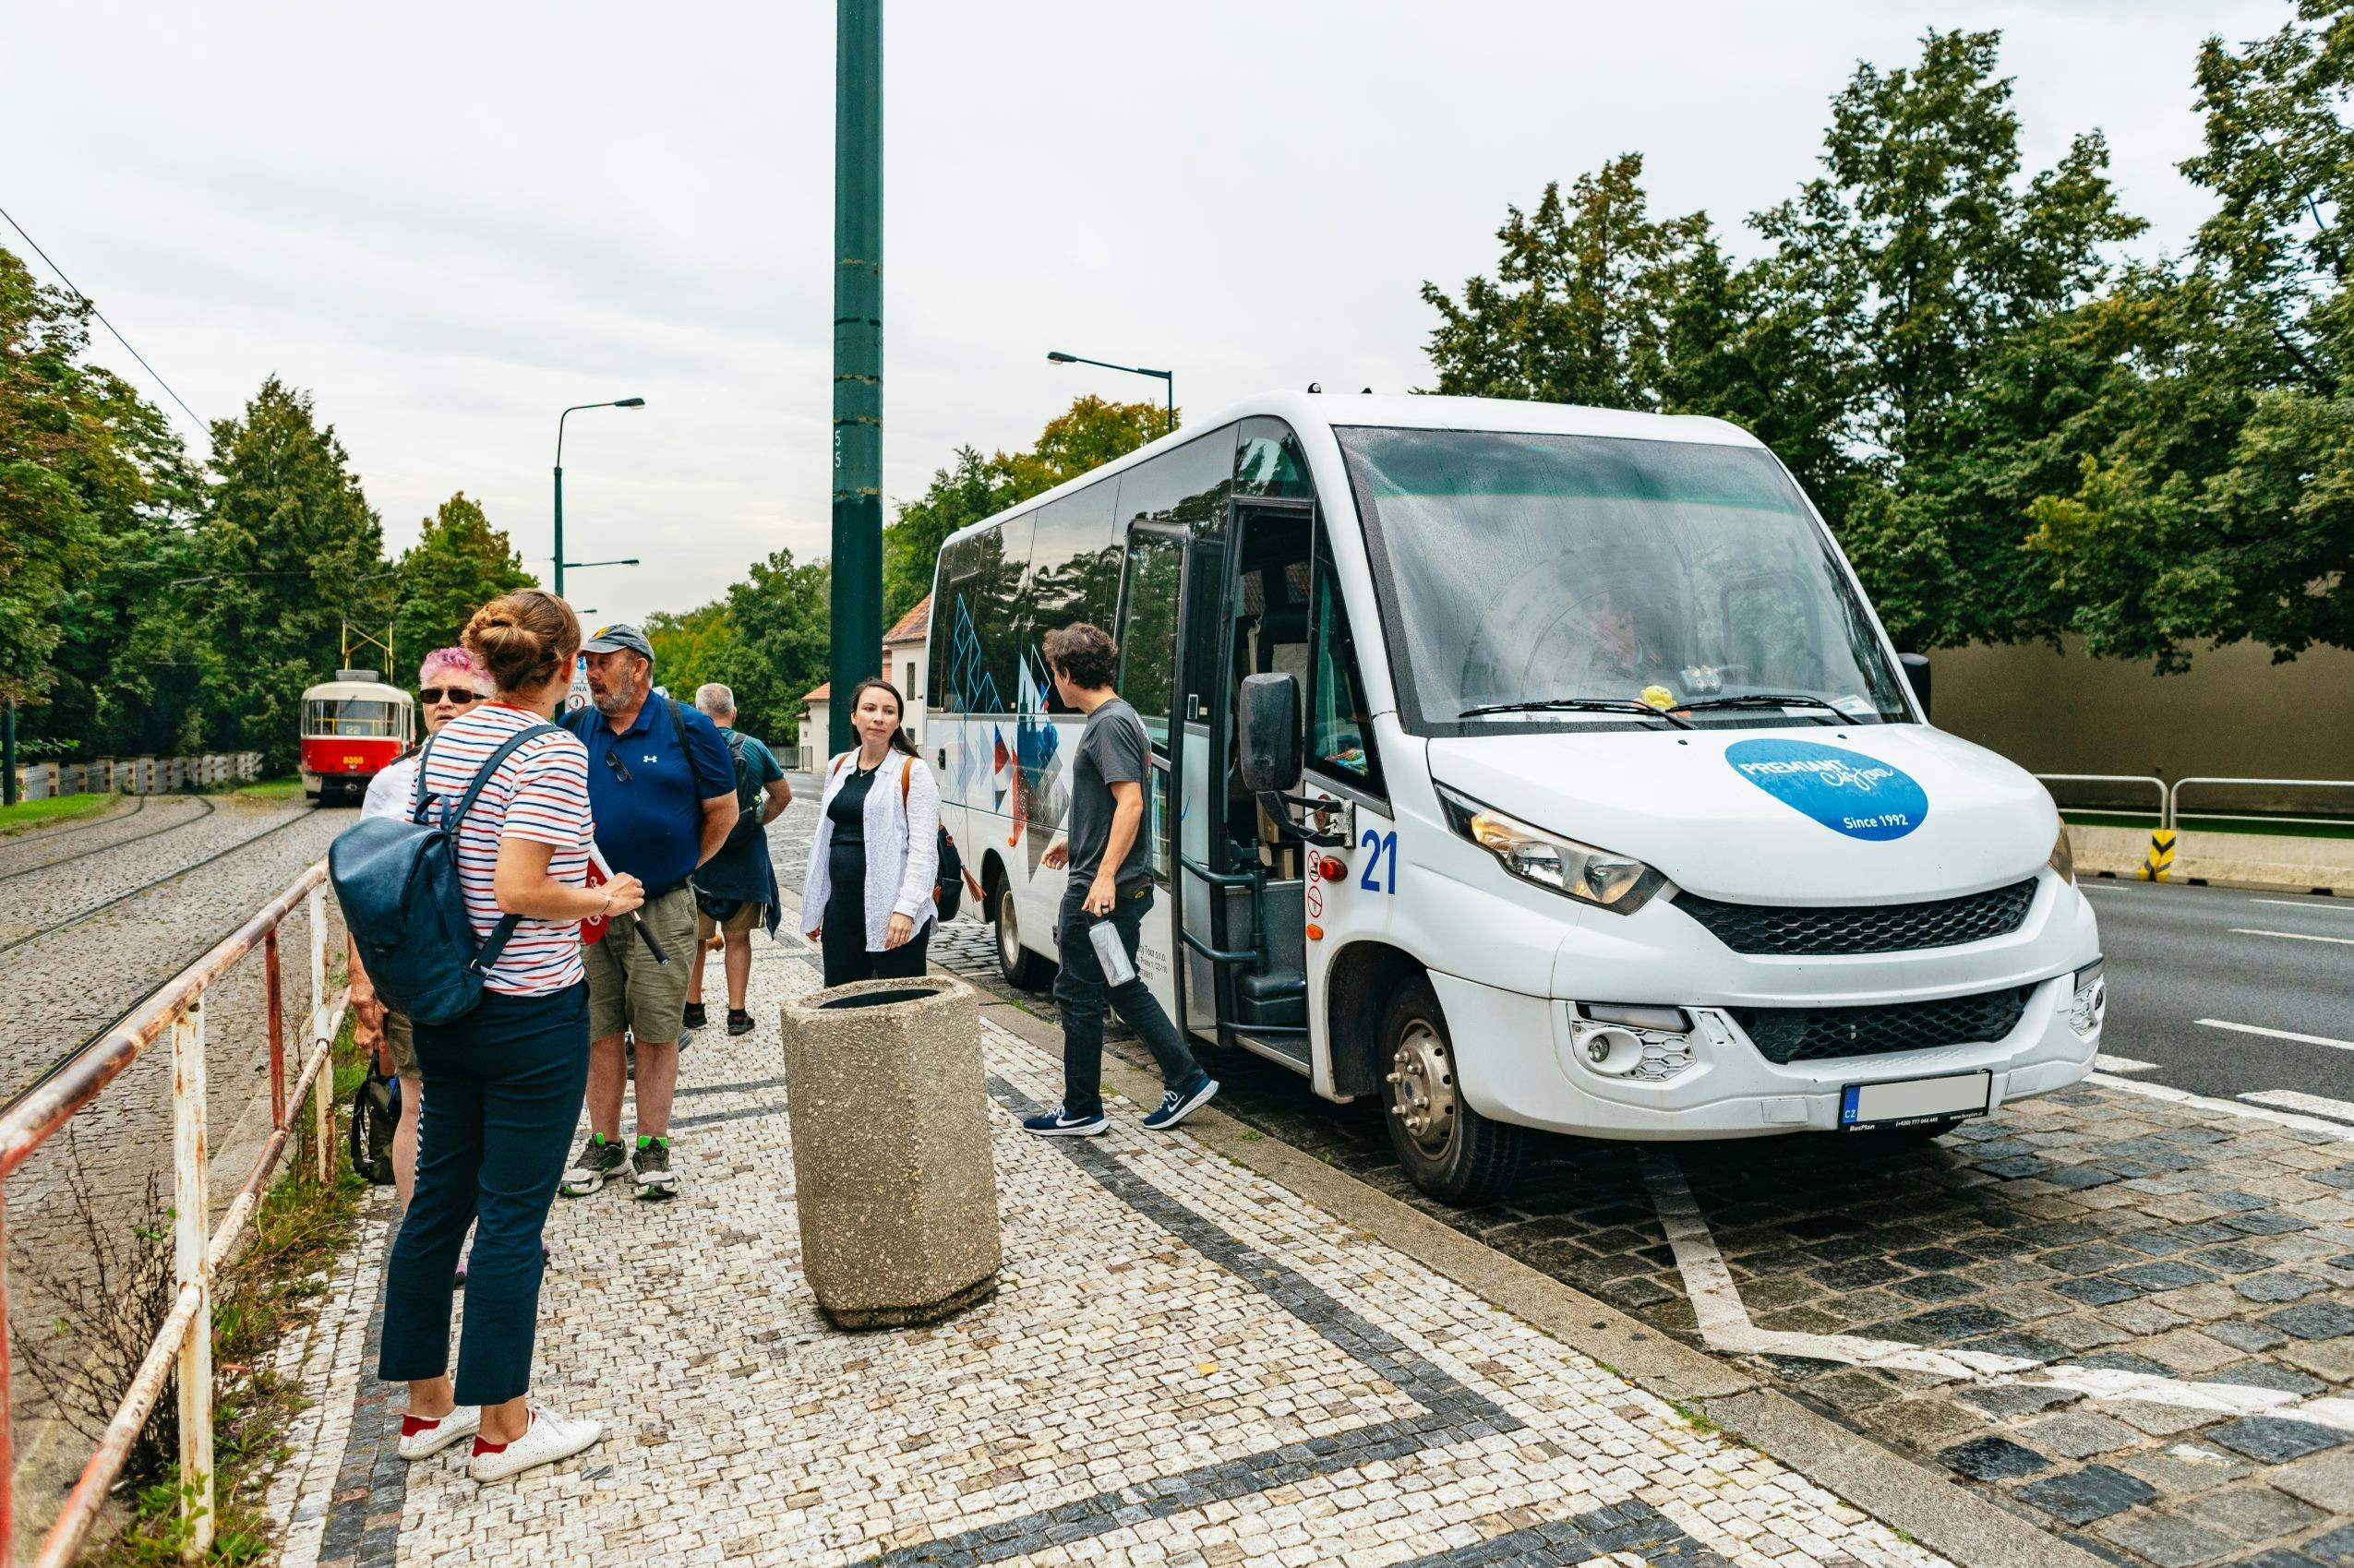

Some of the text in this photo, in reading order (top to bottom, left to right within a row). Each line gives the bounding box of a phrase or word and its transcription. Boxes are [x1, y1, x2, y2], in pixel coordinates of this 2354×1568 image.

[346, 724, 361, 735] 22
[1738, 760, 1851, 775] PREMIANT
[1844, 814, 1909, 830] Since 1992
[1361, 829, 1398, 895] 21
[1844, 1109, 1856, 1118] CZ
